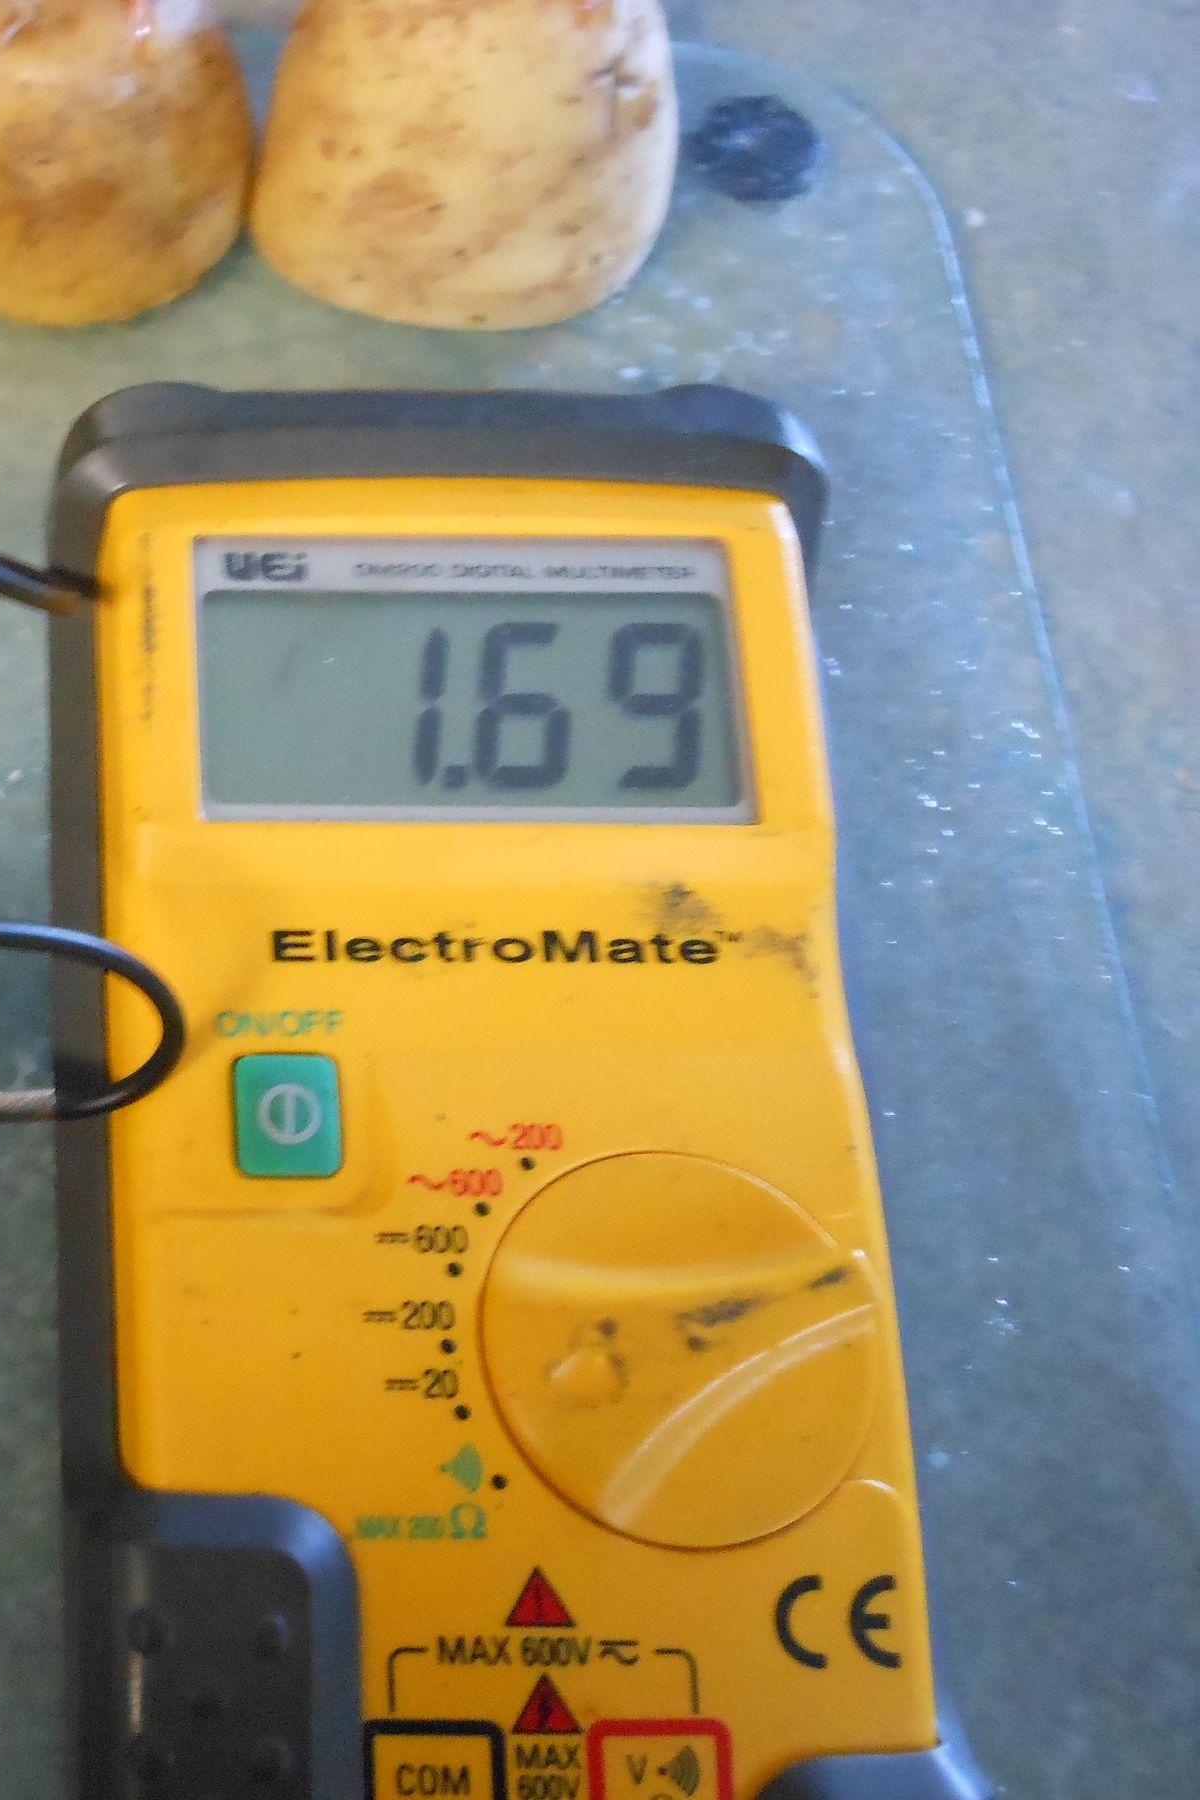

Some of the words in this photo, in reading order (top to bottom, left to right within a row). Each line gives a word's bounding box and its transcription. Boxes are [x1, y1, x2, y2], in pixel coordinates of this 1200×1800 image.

[412, 621, 702, 790] 1.69
[436, 1636, 510, 1666] MAX
[514, 1743, 582, 1770] MAX
[395, 1763, 471, 1796] COM
